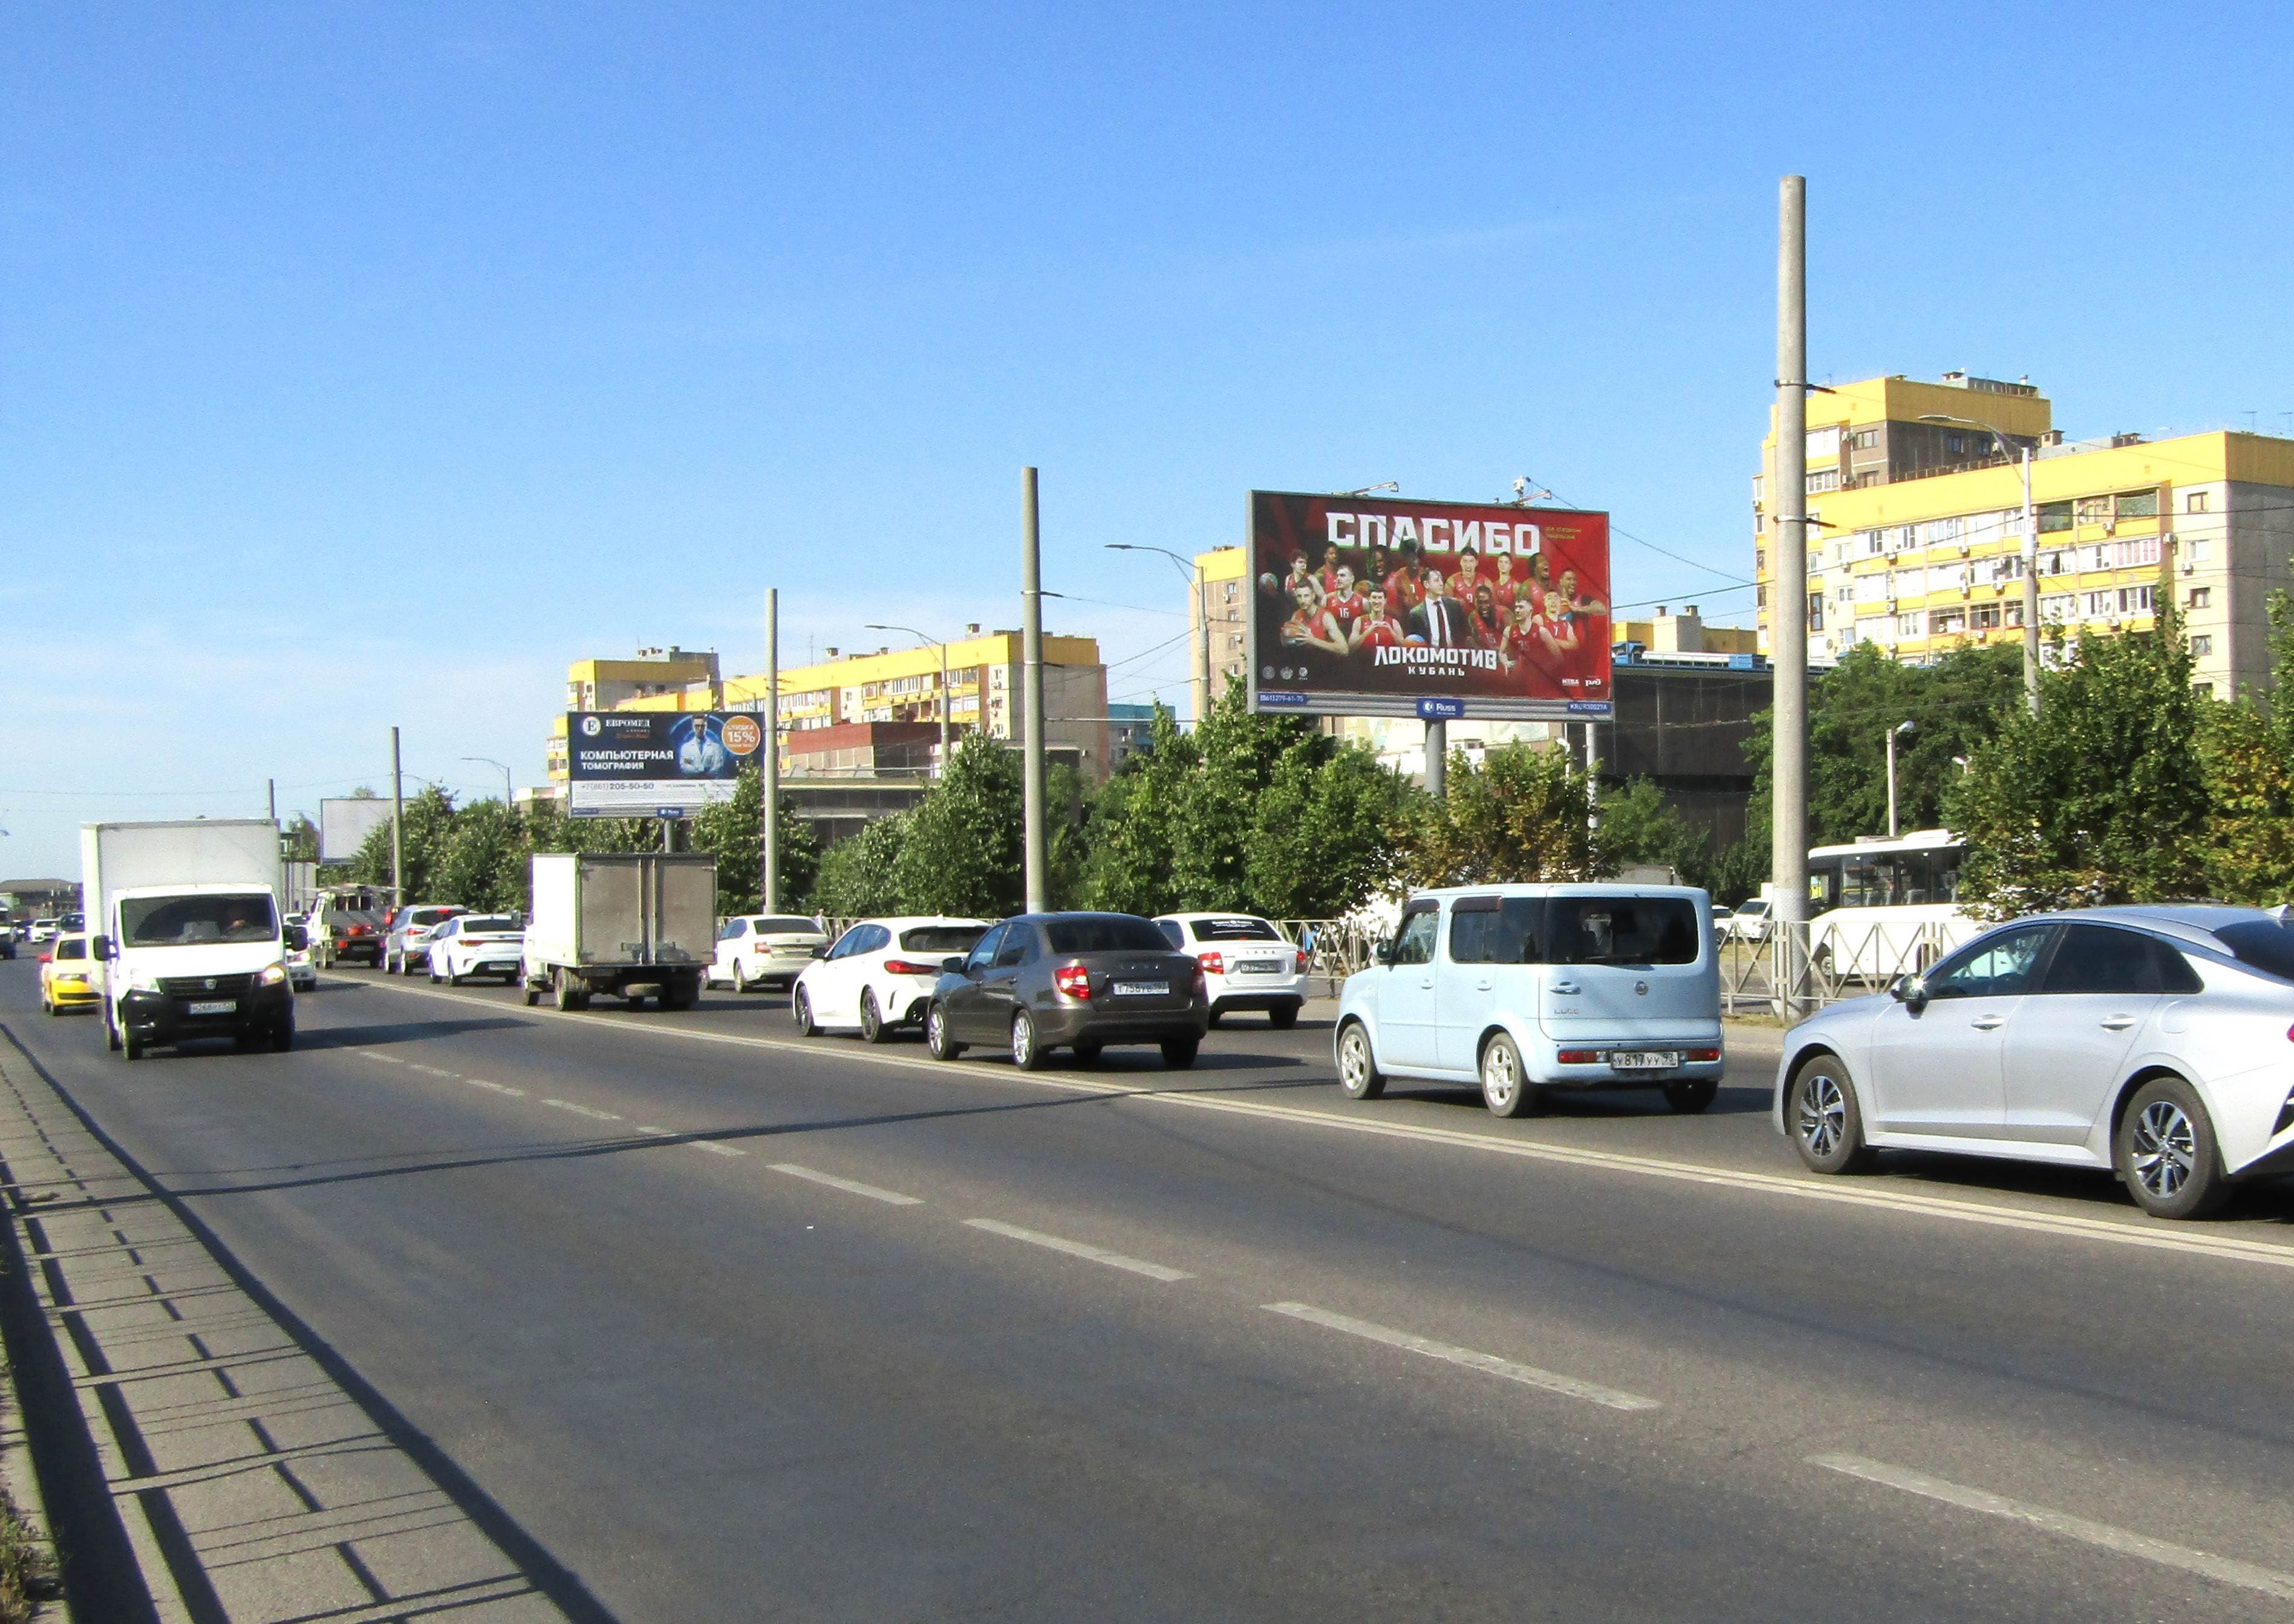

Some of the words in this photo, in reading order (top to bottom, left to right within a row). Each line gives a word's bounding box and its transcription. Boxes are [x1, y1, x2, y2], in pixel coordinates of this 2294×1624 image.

[1326, 512, 1540, 557] СПАСИБО
[1374, 646, 1497, 670] ЛОКОМОТИВ
[1408, 666, 1465, 676] КУБАНЬ
[605, 719, 651, 728] ЕВРОМЕД
[728, 731, 755, 742] 15%
[581, 750, 674, 760] КОМПЬЮТЕРНАЯ
[581, 762, 644, 770] ТОМОГРАФИЯ
